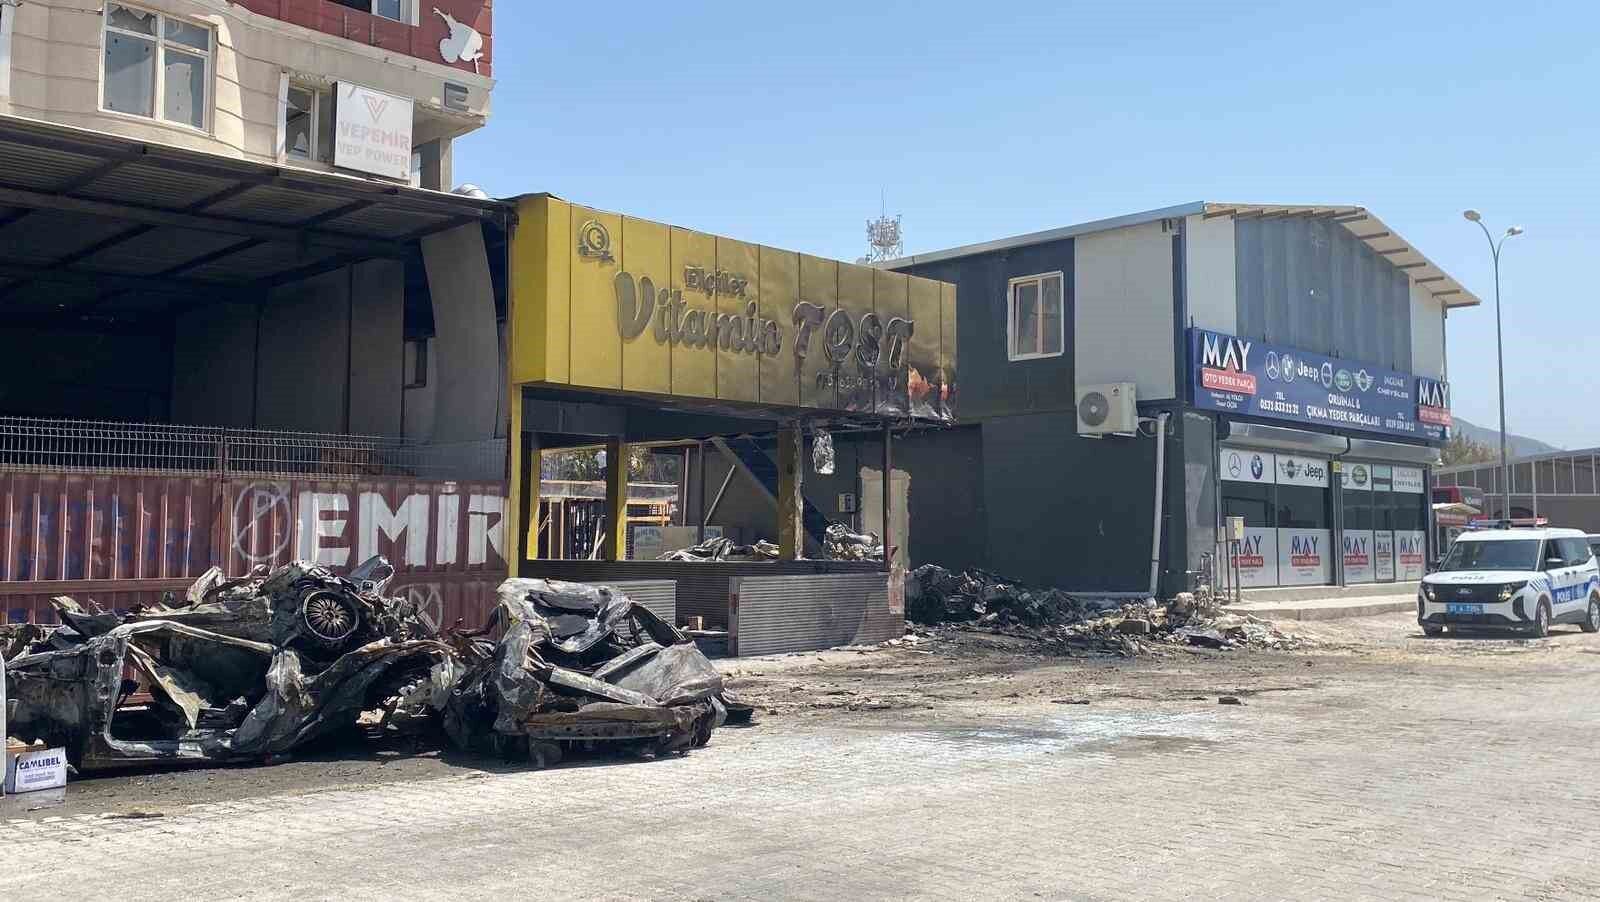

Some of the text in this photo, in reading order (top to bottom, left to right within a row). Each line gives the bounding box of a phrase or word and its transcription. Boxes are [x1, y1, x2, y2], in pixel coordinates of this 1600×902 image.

[614, 271, 784, 355] Vitamin
[1202, 332, 1252, 372] MAY
[1298, 361, 1319, 382] Jeep
[1419, 380, 1449, 409] MAY
[1304, 464, 1324, 481] Jeep
[1231, 536, 1262, 555] MAY
[1290, 536, 1319, 555] MAY
[1344, 537, 1368, 554] MAY
[1400, 537, 1422, 553] MAY
